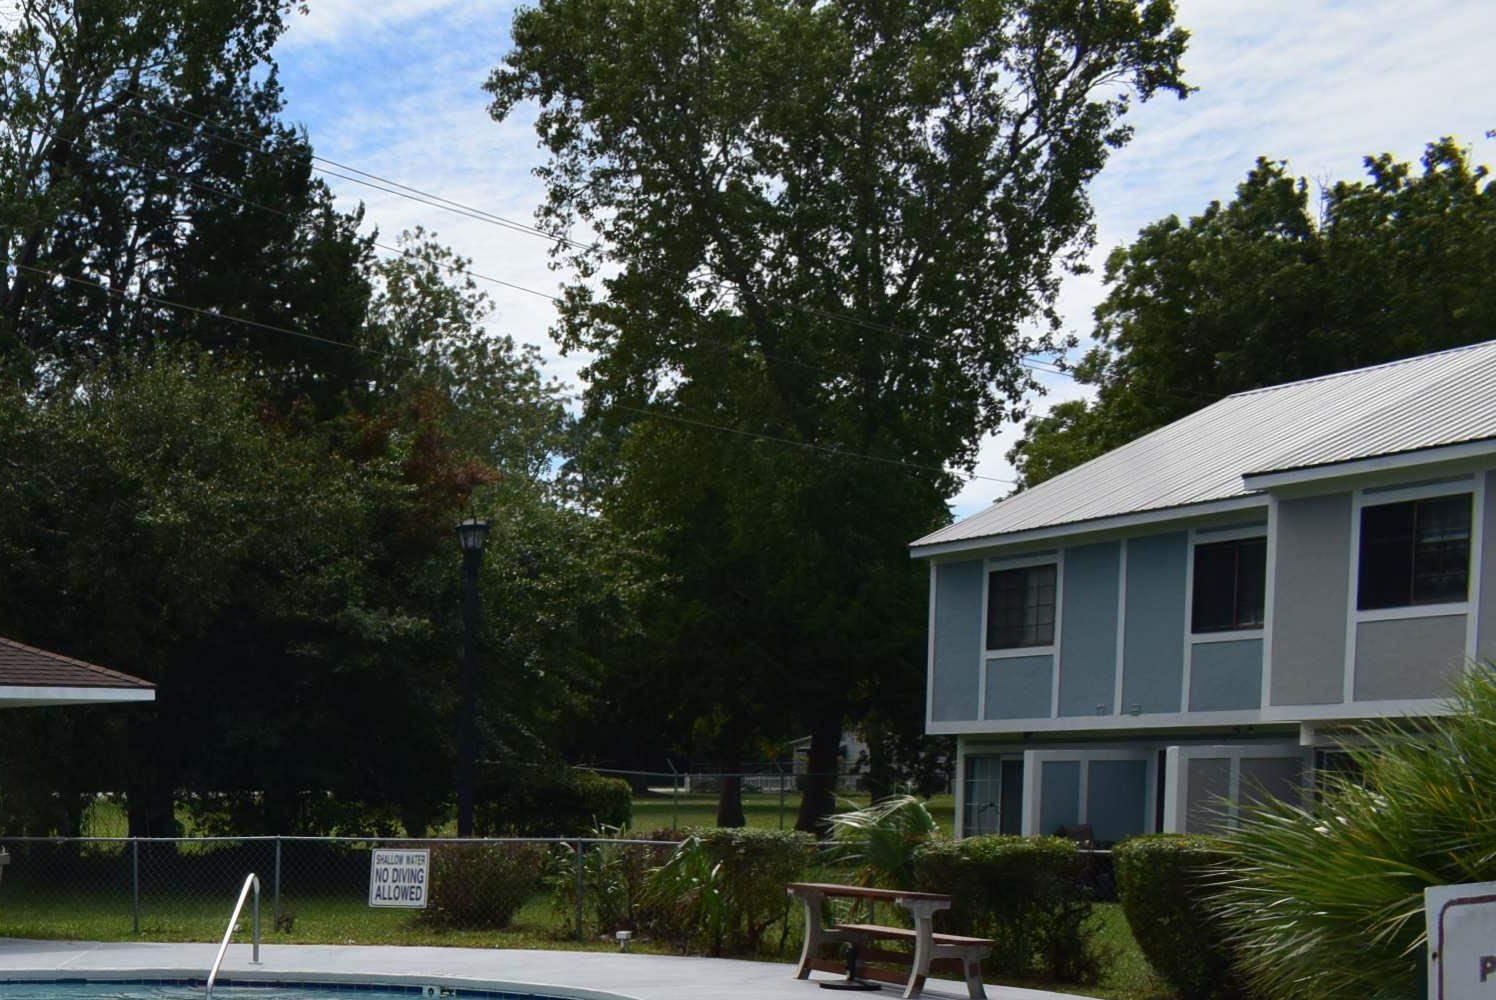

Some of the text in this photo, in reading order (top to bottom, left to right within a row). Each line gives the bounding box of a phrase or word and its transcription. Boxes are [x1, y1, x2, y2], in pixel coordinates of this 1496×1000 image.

[376, 854, 404, 865] SHALLOW
[375, 868, 425, 884] NO DIVING
[375, 885, 423, 901] ALLOWED
